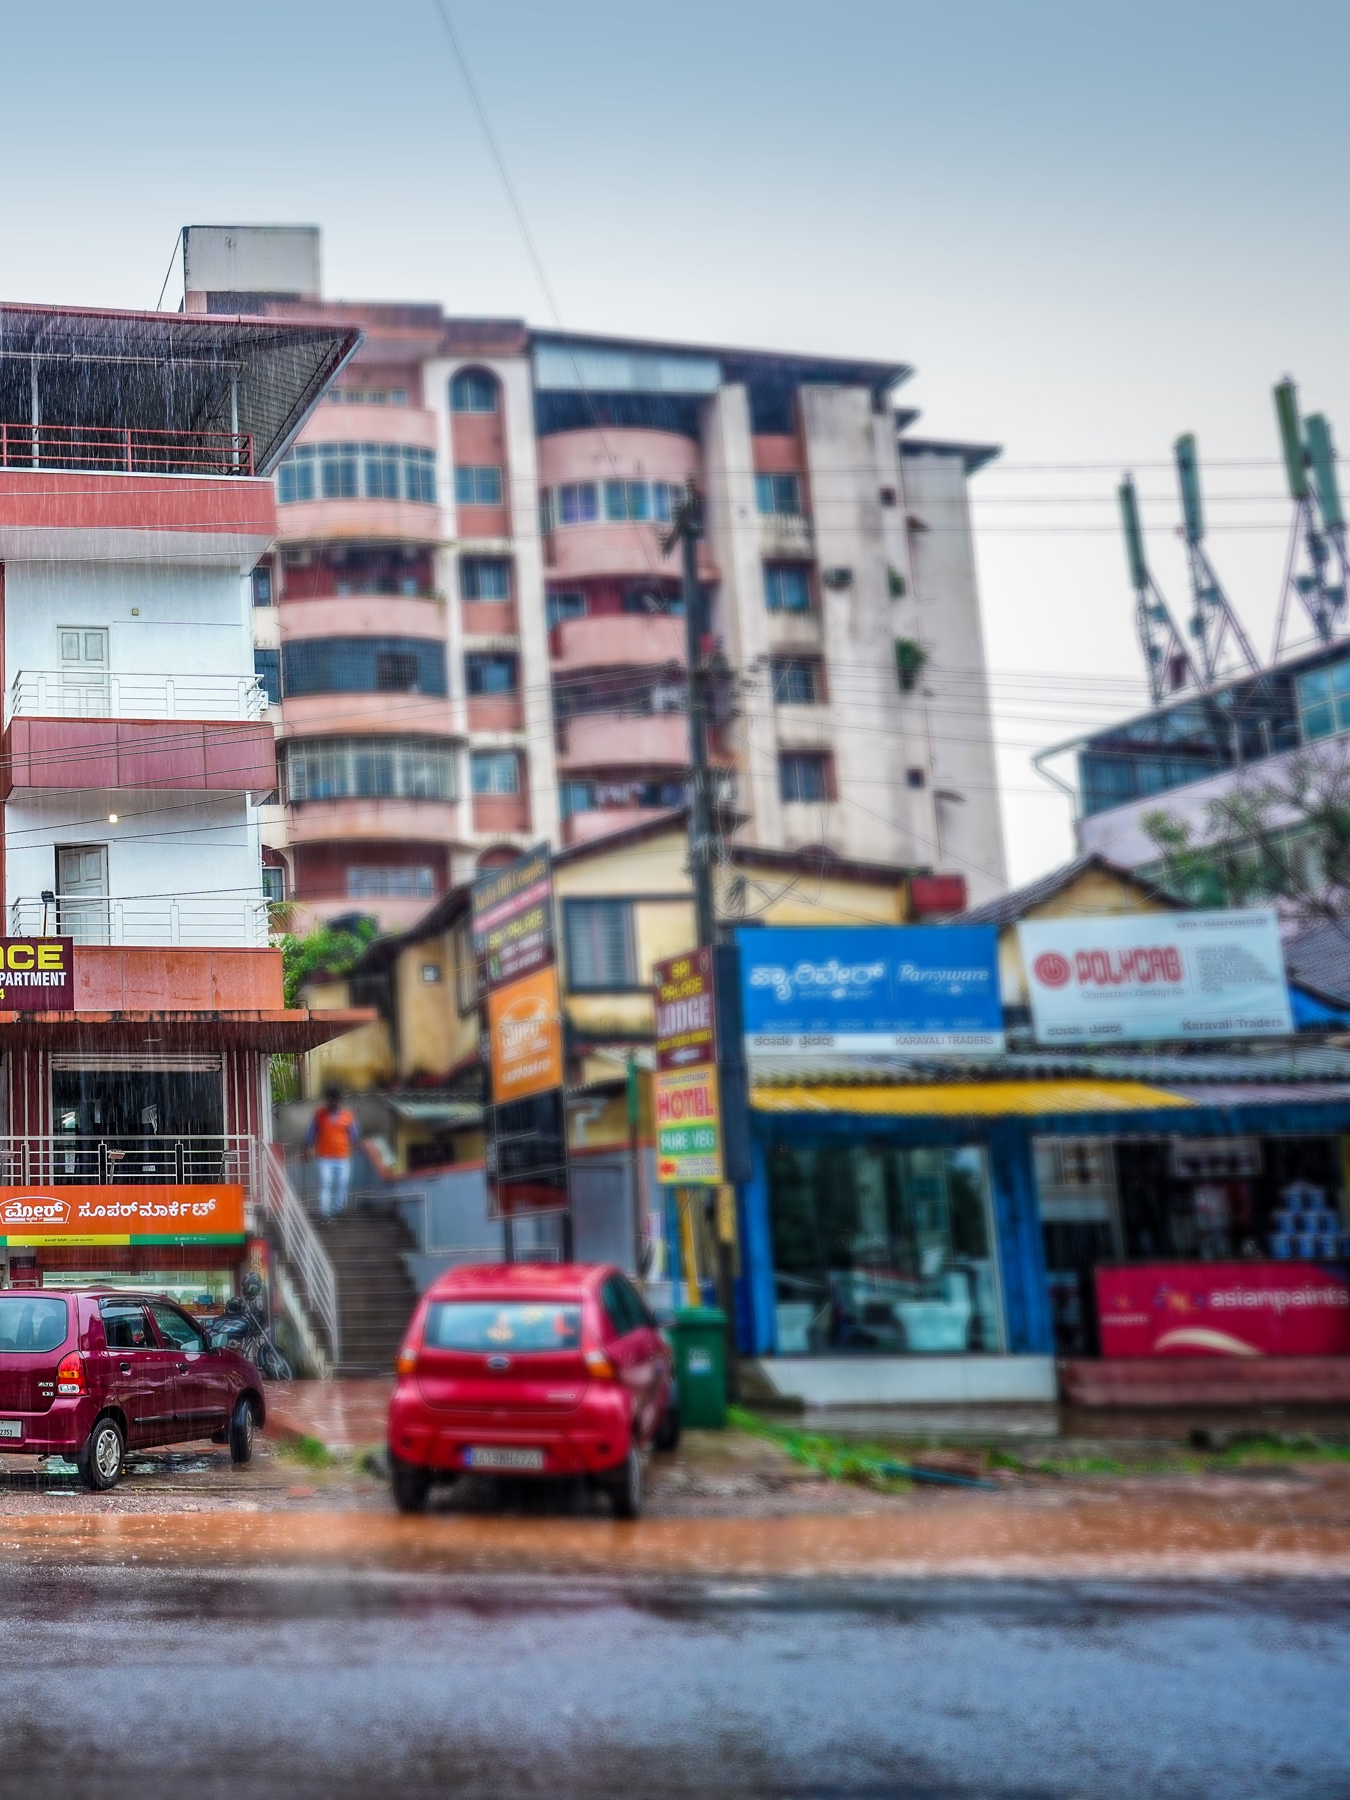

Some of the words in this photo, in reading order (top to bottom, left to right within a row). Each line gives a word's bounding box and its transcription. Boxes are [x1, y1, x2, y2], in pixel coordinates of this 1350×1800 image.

[899, 964, 989, 985] Parryware
[1075, 946, 1182, 986] POLYCAB
[1082, 990, 1132, 999] Connection
[657, 994, 711, 1037] LODGE
[1182, 1019, 1232, 1031] Karavali
[1236, 1018, 1284, 1029] Traders
[895, 1036, 945, 1046] KARAVALI
[948, 1036, 994, 1045] TRADERS
[657, 1087, 715, 1122] HOTEL
[661, 1131, 689, 1152] PURE
[691, 1129, 715, 1150] VEG
[1210, 1284, 1349, 1315] asianpaints
